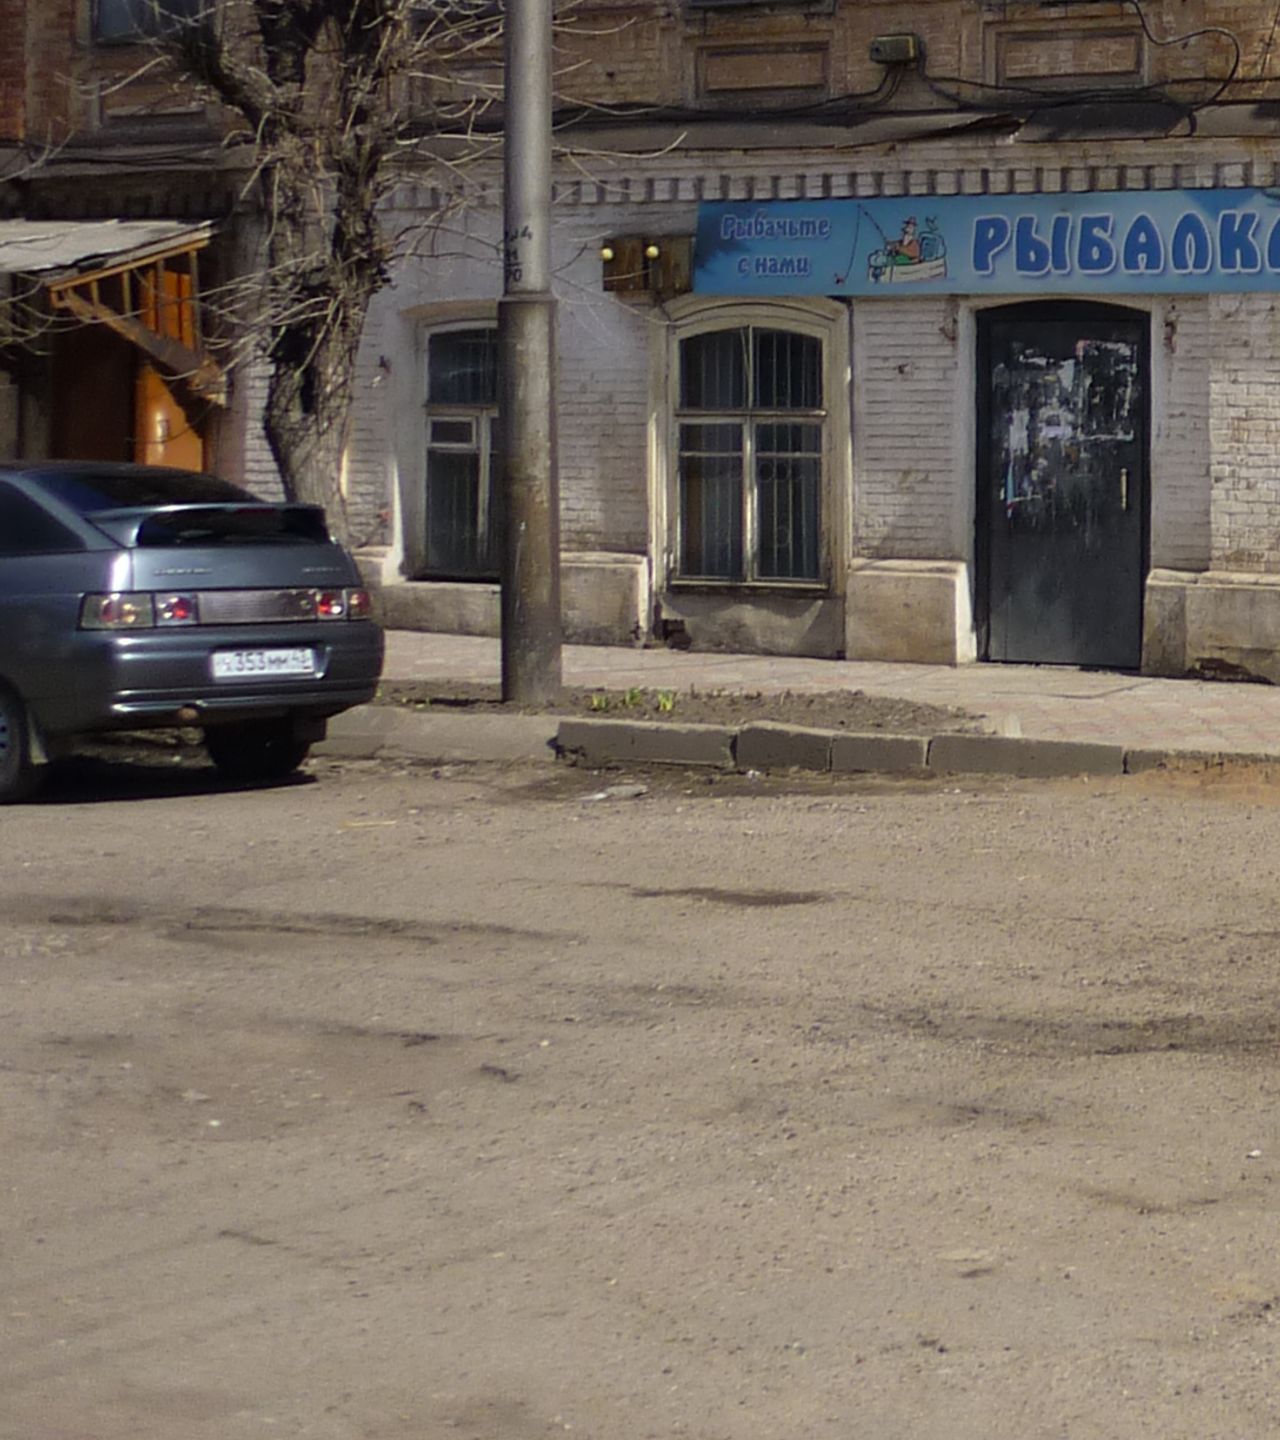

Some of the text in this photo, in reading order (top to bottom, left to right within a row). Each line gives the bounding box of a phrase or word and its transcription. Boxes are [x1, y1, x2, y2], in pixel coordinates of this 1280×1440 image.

[722, 214, 831, 239] Рыбачьте
[738, 257, 810, 276] с нами
